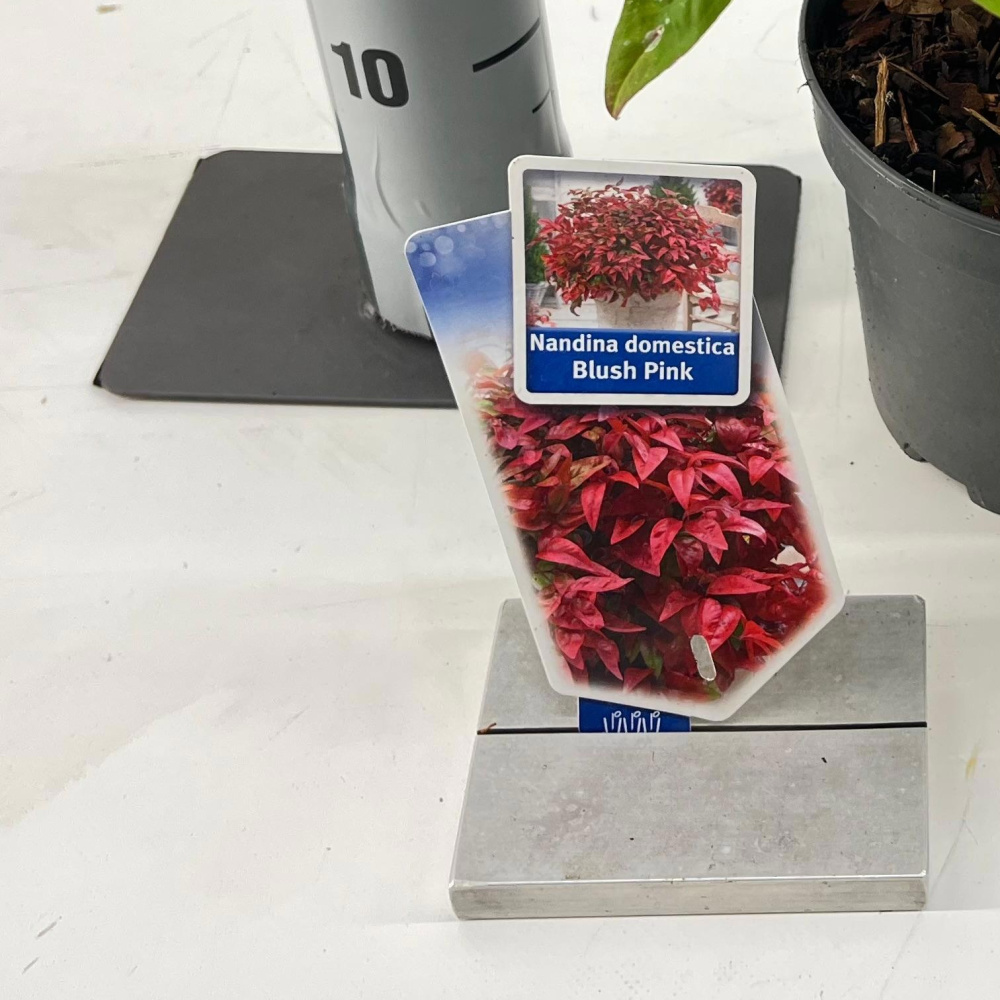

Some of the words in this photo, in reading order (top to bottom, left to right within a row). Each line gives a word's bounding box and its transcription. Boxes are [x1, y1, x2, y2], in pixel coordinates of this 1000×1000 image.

[330, 40, 410, 109] 10
[530, 333, 619, 353] Nandina
[625, 335, 735, 356] domestica
[572, 360, 637, 380] Blush
[644, 361, 694, 381] Pink
